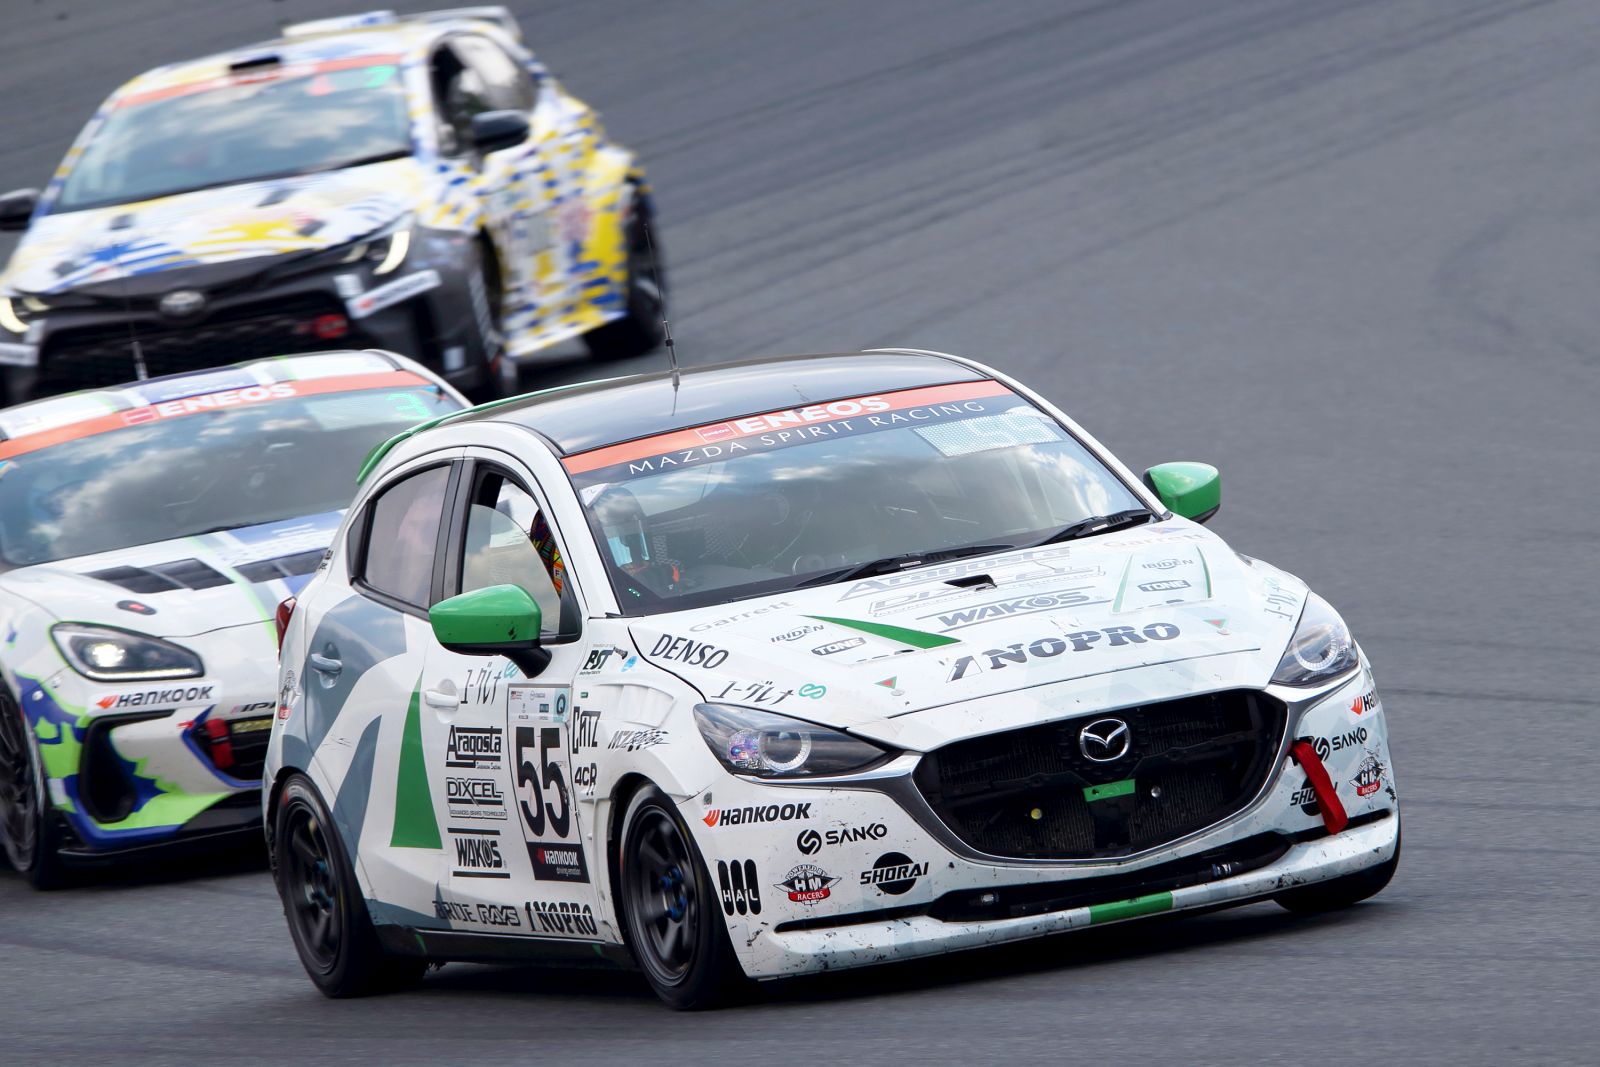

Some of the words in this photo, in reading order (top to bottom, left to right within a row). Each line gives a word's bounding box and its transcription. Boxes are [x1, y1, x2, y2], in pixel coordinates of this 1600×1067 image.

[156, 383, 297, 417] ENEOS
[735, 397, 890, 434] ENEOS
[630, 441, 748, 475] MAZDA
[761, 421, 855, 446] SPIRIT
[868, 401, 985, 428] RACING
[1142, 558, 1194, 570] IBIDEN
[1143, 580, 1187, 592] TONE
[689, 601, 795, 632] Garrett
[771, 624, 824, 643] IBIDEN
[650, 633, 730, 669] DENSO
[815, 638, 866, 655] TONE
[446, 725, 502, 761] Aragosta
[1332, 727, 1368, 751] SANKO
[515, 727, 571, 839] 55
[574, 763, 597, 787] 4CR
[447, 781, 502, 800] DIXCEL
[825, 823, 888, 845] SANKO
[860, 862, 930, 886] SHORAI
[722, 888, 759, 903] HAL
[797, 891, 825, 901] RACERS
[476, 903, 521, 927] RAYS
